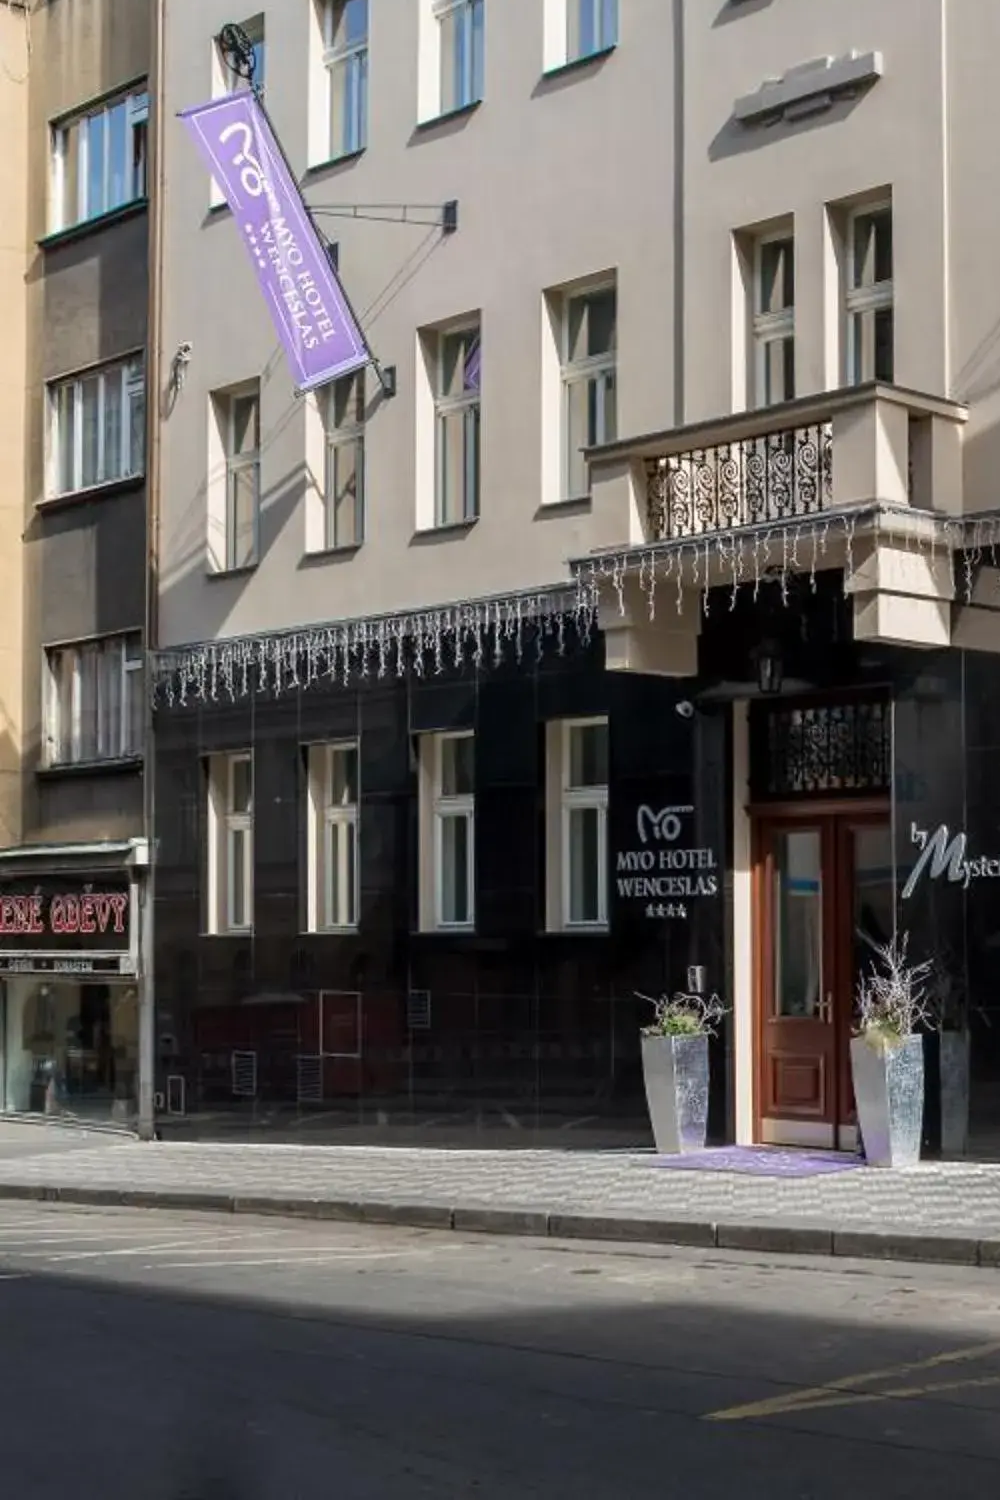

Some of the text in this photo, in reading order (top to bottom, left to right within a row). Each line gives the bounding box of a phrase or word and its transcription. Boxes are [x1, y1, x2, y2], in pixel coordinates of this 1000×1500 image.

[260, 220, 320, 350] WENCESLAS
[270, 216, 337, 342] MYO HOTEL
[911, 820, 929, 851] by
[616, 846, 719, 871] MYO HOTEL
[616, 874, 719, 898] WENCESLAS
